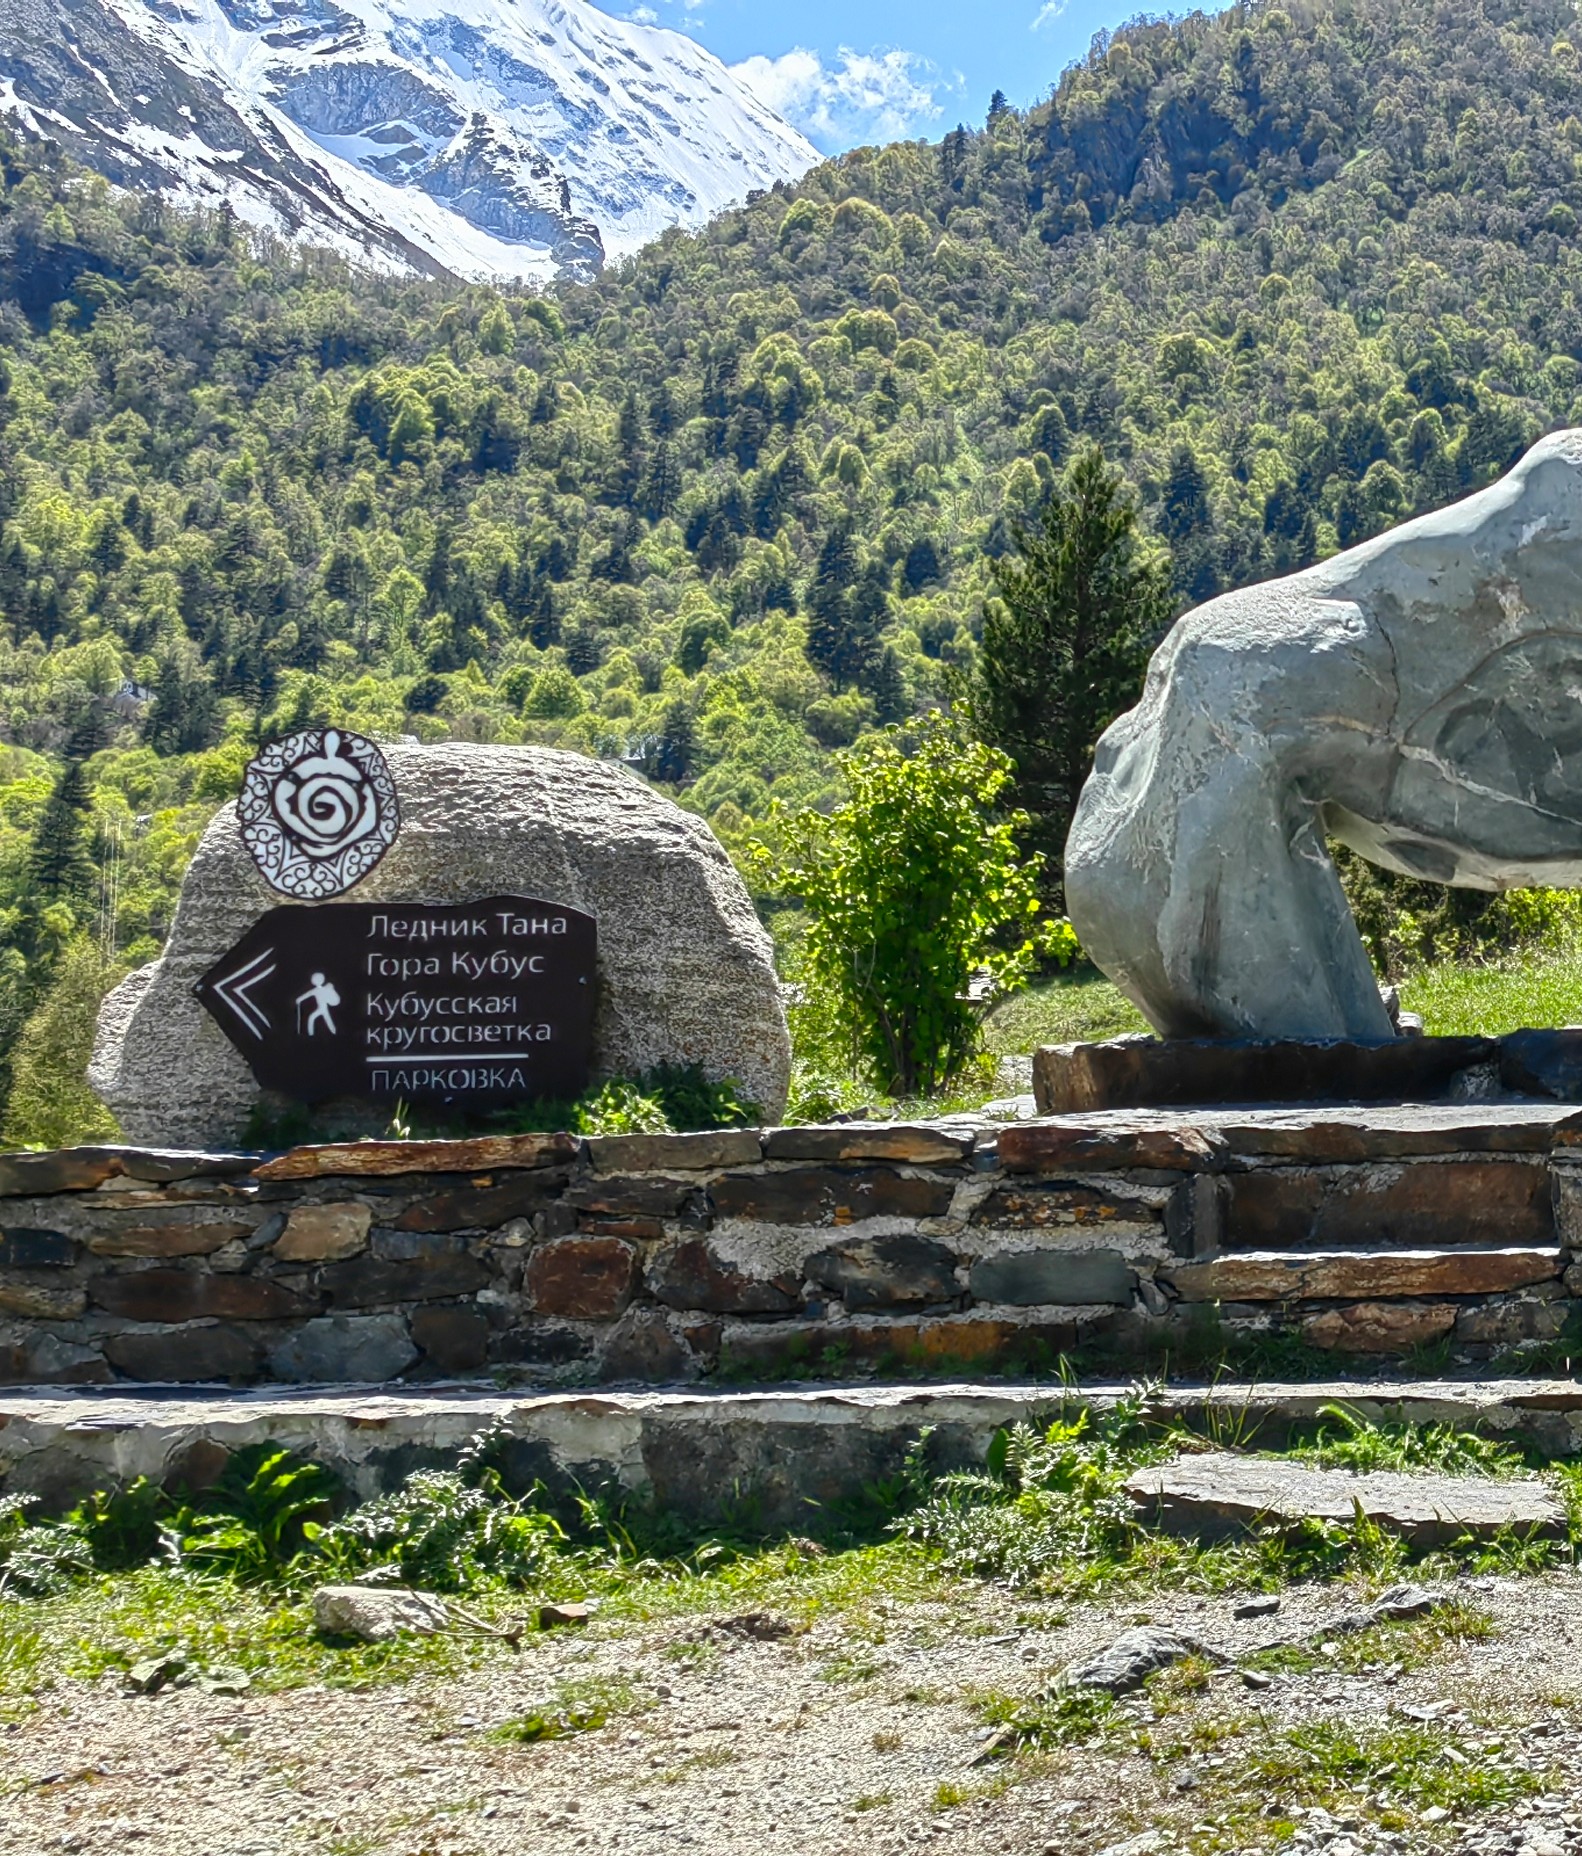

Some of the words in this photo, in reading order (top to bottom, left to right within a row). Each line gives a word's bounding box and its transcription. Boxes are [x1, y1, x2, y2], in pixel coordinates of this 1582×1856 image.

[367, 914, 488, 941] Ледник
[496, 912, 568, 937] Тана
[367, 952, 440, 981] Гора
[452, 949, 544, 980] Кубус
[367, 991, 517, 1022] Кубусская
[367, 1023, 551, 1050] кругосветка
[371, 1067, 526, 1091] ПАРКОВКА
